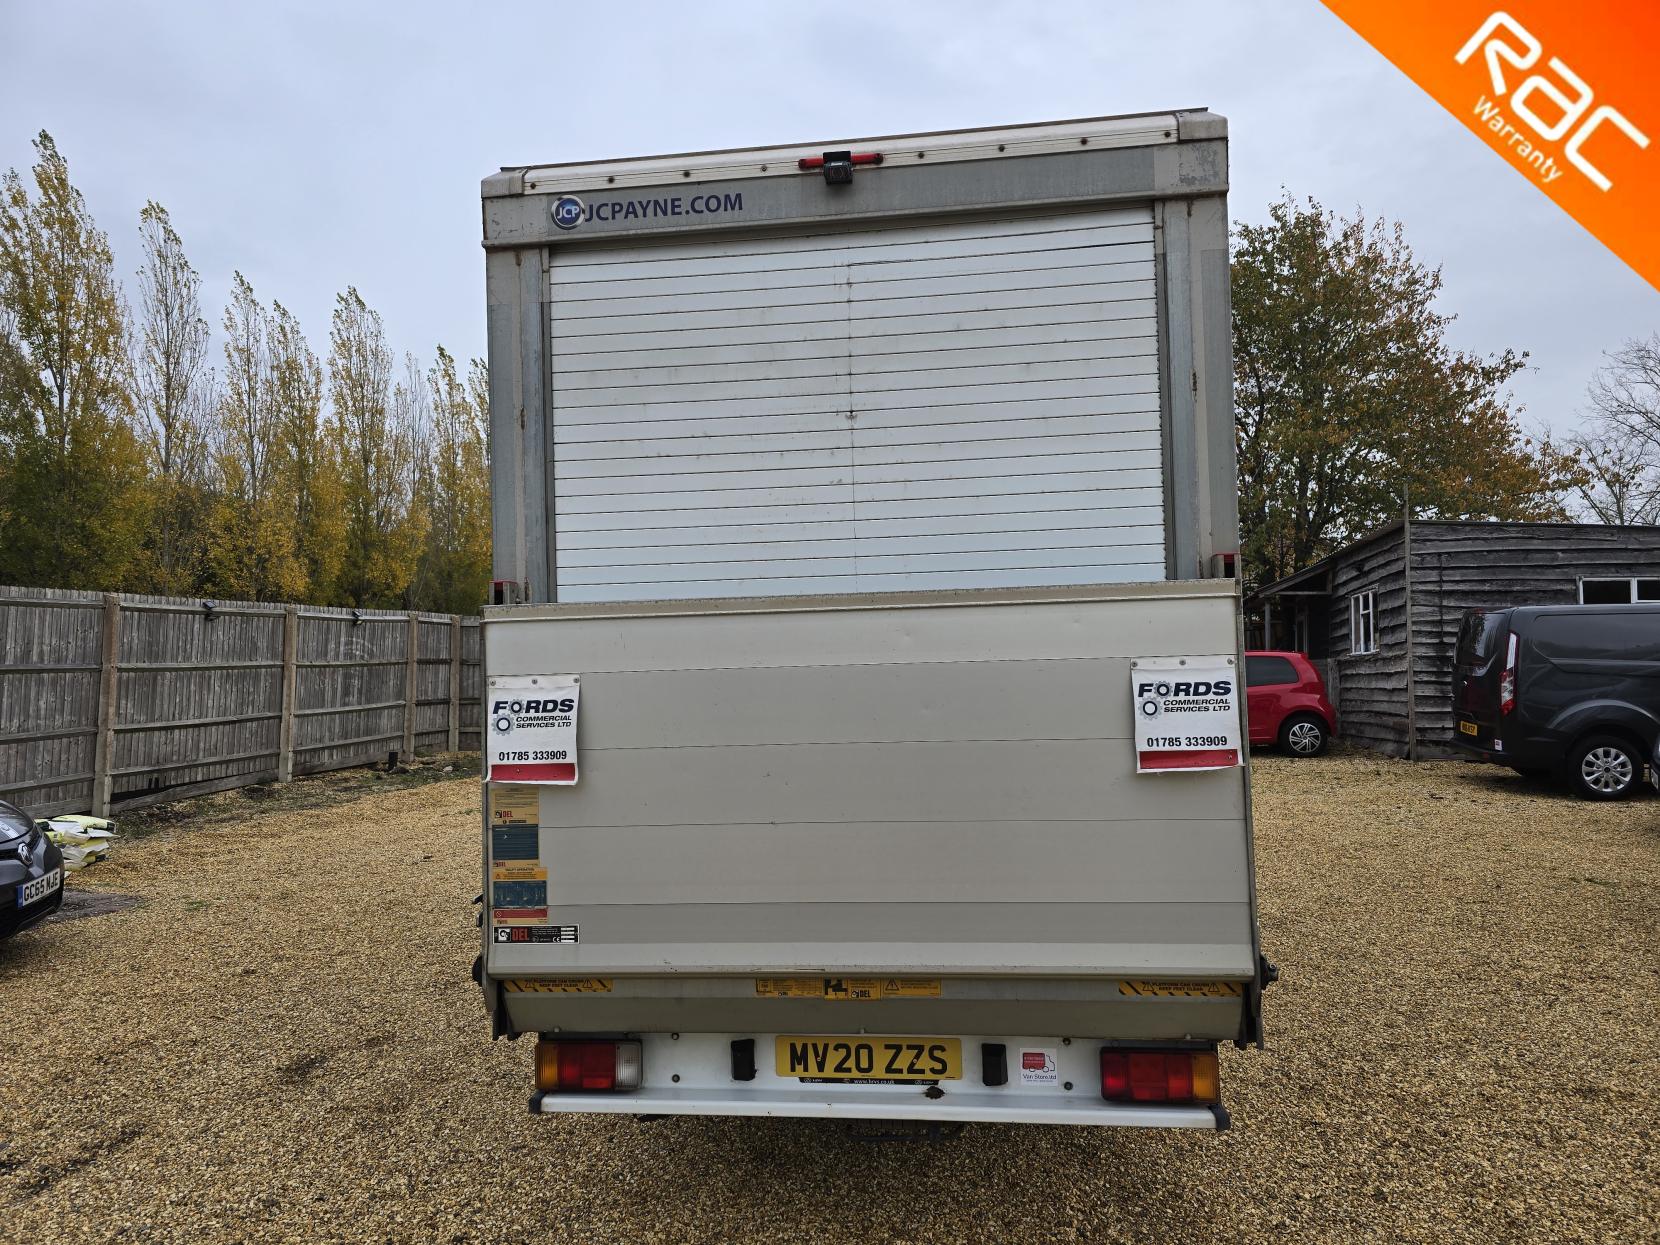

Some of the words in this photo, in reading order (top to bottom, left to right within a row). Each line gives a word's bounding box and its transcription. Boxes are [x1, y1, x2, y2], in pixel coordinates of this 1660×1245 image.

[557, 206, 580, 219] JCP
[585, 192, 743, 223] JCPAYNE.COM
[1138, 681, 1232, 697] FORDS
[492, 698, 575, 715] FORDS
[516, 715, 572, 723] COMMERCIAL
[1147, 737, 1182, 747] 01785
[1185, 736, 1228, 746] 333909
[498, 751, 530, 761] 01785
[532, 750, 567, 761] 333909
[24, 879, 45, 902] GC65
[789, 1042, 874, 1073] MV20
[884, 1044, 948, 1075] ZZS
